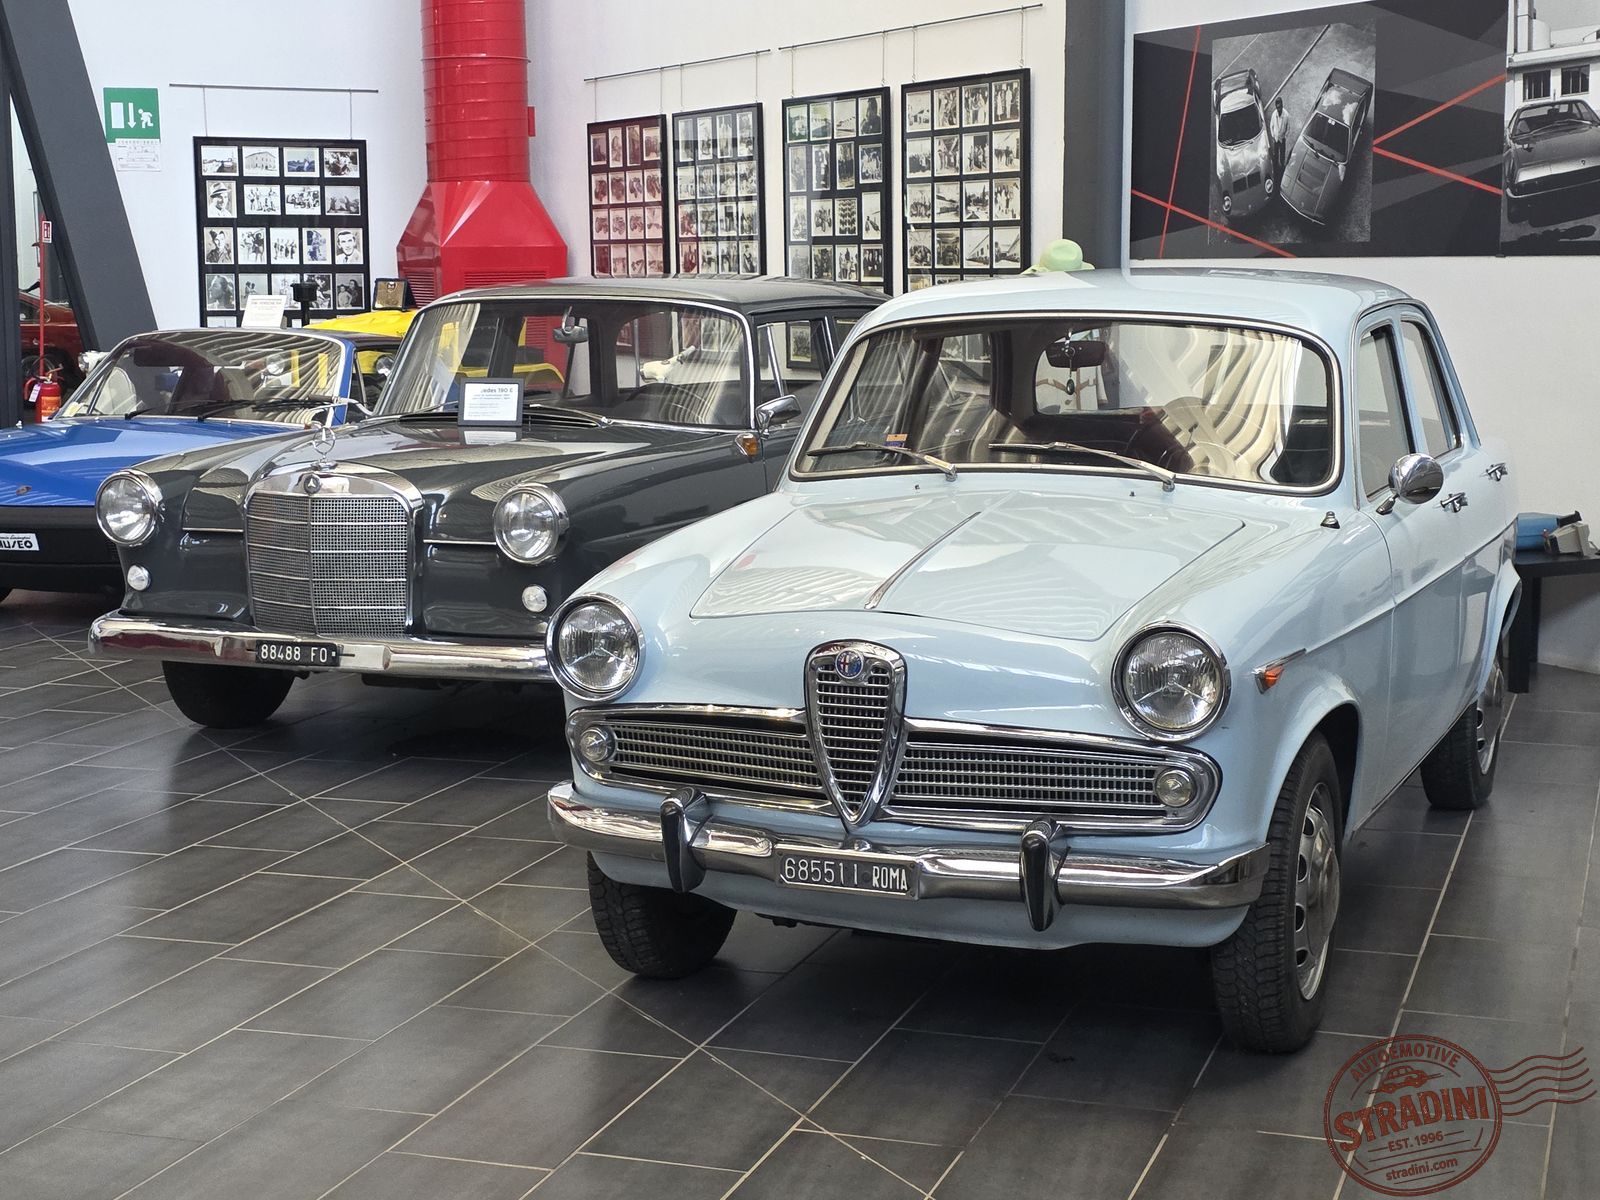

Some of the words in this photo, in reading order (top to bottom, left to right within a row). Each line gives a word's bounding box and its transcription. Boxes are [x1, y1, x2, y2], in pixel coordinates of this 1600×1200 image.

[261, 644, 301, 661] 88488
[310, 647, 328, 663] FO
[785, 857, 858, 885] 685511
[872, 865, 908, 891] ROMA
